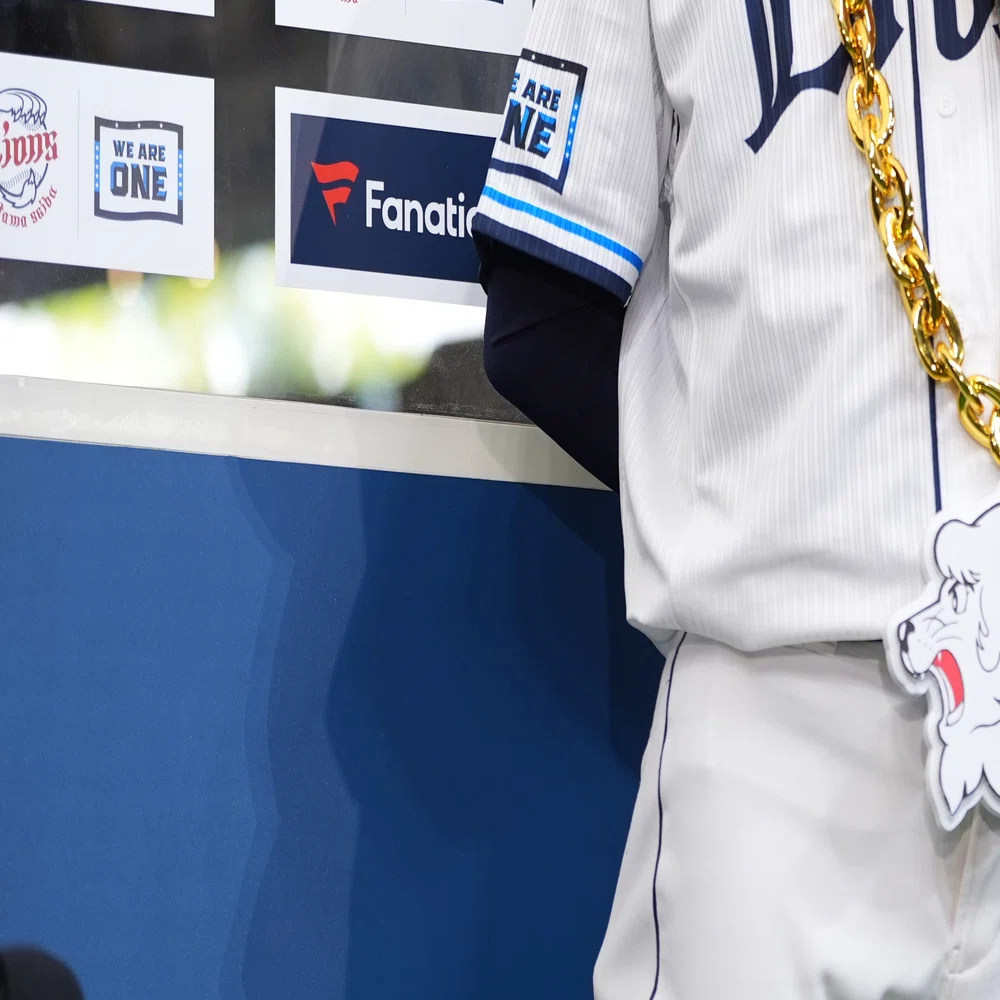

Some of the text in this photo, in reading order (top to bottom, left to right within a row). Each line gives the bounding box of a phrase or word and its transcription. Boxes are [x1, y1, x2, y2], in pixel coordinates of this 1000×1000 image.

[521, 79, 561, 112] ARE
[0, 120, 58, 168] ions
[500, 98, 557, 159] NE
[112, 139, 166, 161] WE ARE
[110, 161, 168, 202] ONE
